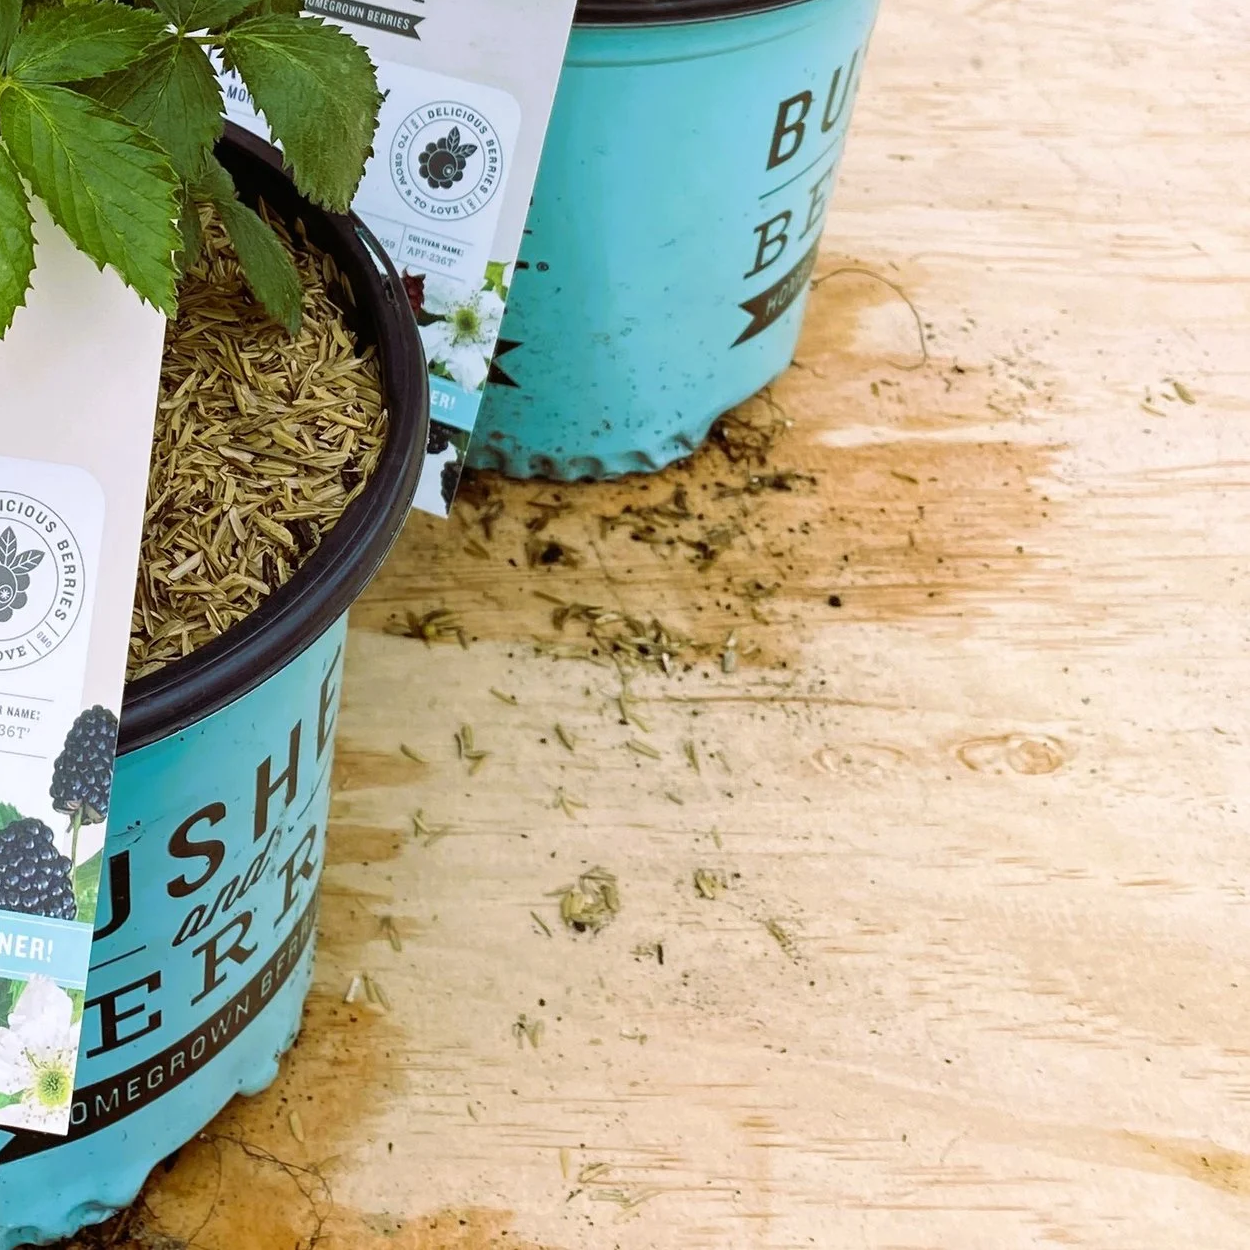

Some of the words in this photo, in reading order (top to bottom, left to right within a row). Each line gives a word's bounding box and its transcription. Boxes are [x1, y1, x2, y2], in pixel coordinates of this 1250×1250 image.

[366, 2, 410, 30] BERRIES
[397, 134, 409, 149] TO
[427, 106, 488, 135] DELICIOUS
[479, 139, 498, 194] BERRIES
[395, 152, 408, 186] GROW
[413, 196, 427, 209] TO
[430, 205, 460, 215] LOVE
[408, 234, 440, 250] CULTIVAR
[53, 539, 77, 622] BERRIES
[6, 705, 41, 721] NAME:
[171, 826, 283, 948] and
[84, 823, 319, 1059] ERR
[70, 995, 250, 1125] OMEGROWN
